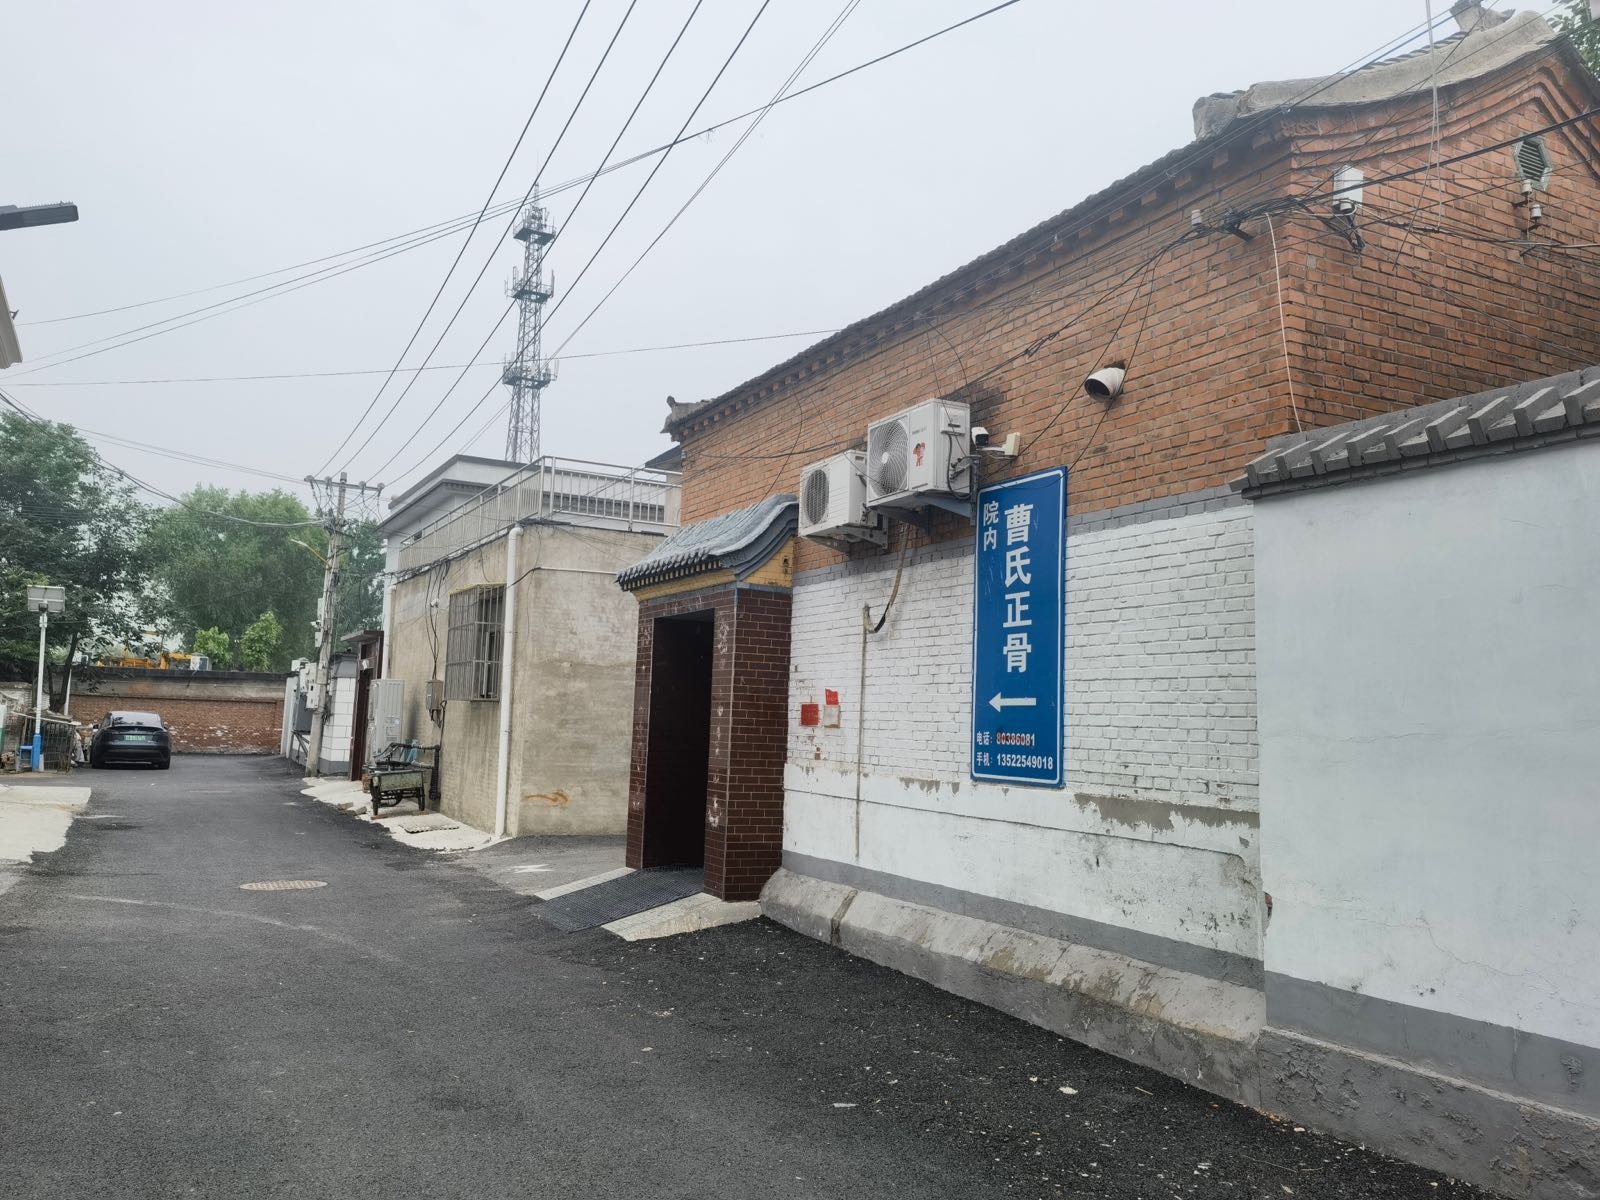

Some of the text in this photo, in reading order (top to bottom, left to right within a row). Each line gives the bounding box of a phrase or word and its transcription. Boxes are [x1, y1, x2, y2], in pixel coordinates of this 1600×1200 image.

[983, 500, 998, 551] 院内
[1003, 503, 1034, 673] 曹氏正骨
[997, 753, 1053, 770] 13522549018
